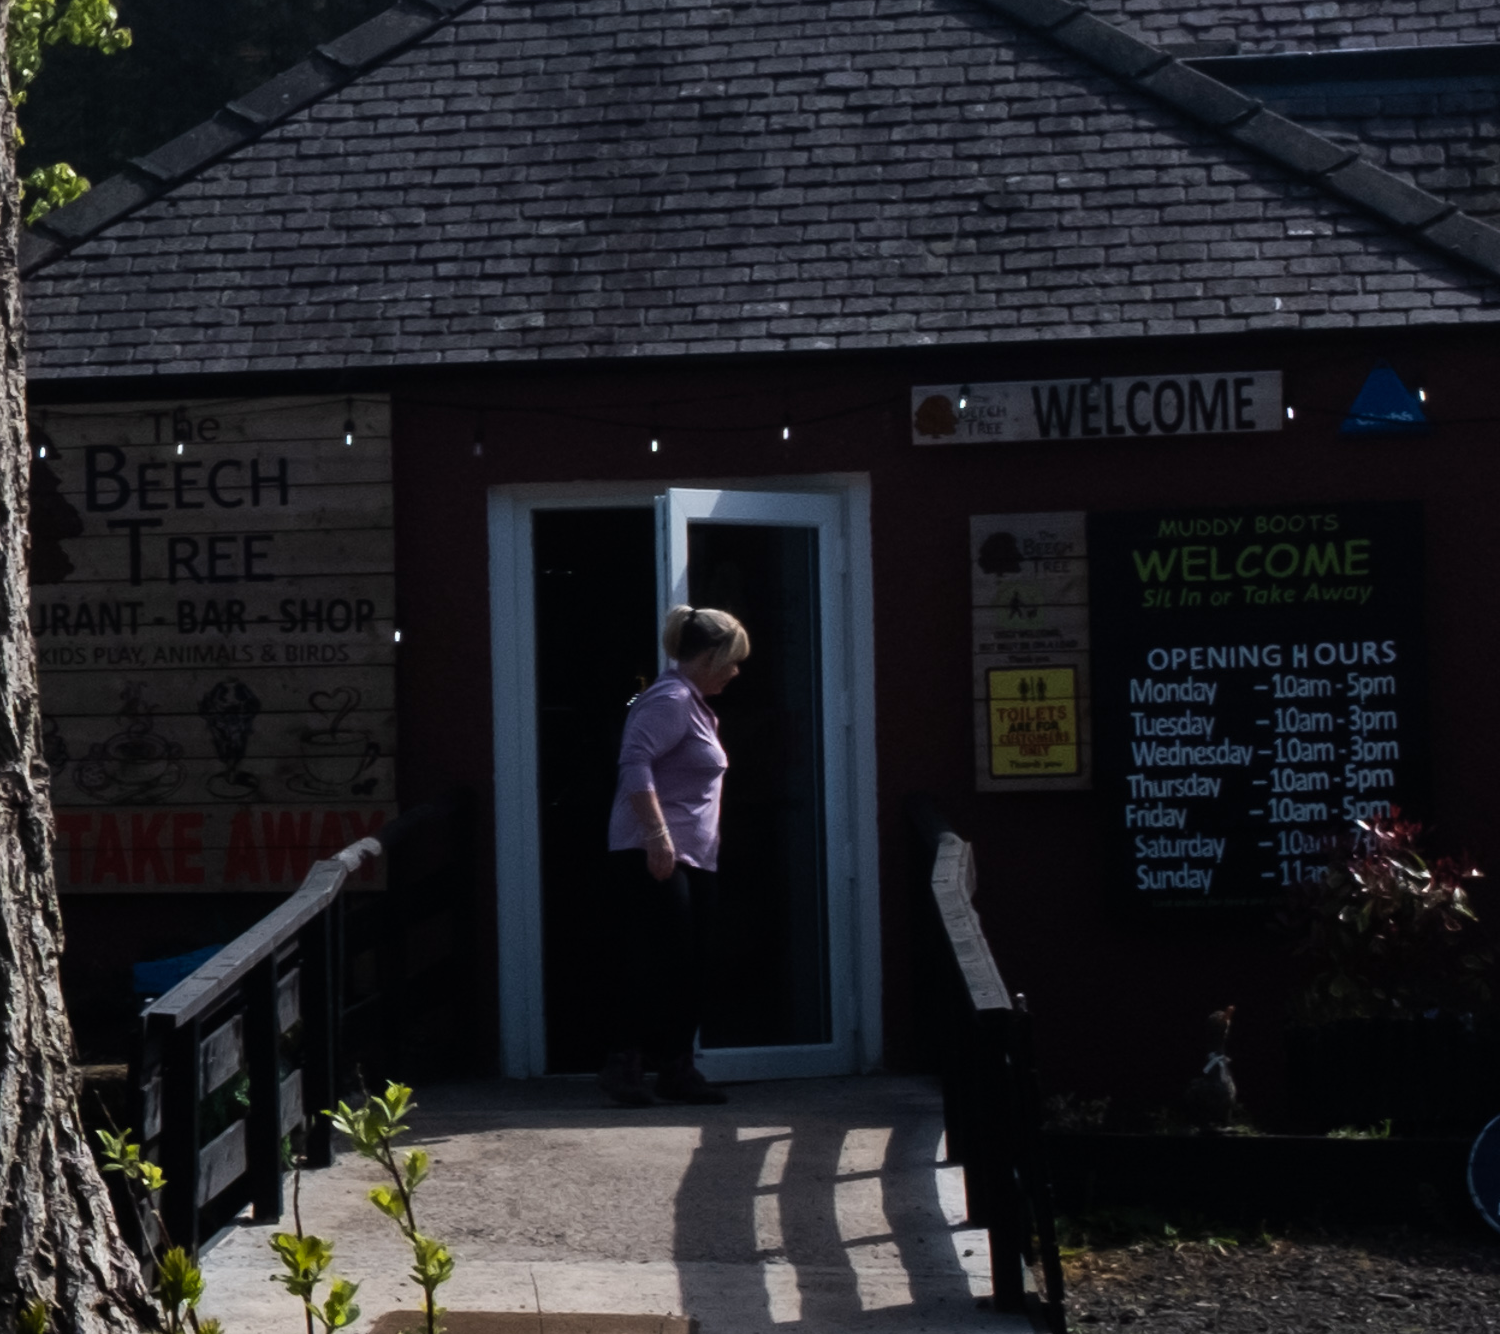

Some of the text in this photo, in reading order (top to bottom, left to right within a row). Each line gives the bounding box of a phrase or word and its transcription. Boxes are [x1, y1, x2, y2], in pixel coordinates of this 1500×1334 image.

[1032, 378, 1256, 437] WELCOME
[148, 407, 220, 443] The
[965, 418, 1003, 436] TREE
[85, 444, 288, 512] BEECH
[1156, 514, 1340, 538] MUDDY BOOTS
[107, 519, 275, 585] TREE
[1131, 538, 1372, 583] WELCOME
[1142, 581, 1374, 608] Sit In or Take Away
[177, 600, 246, 634] BAR
[279, 598, 374, 633] SHOP
[40, 643, 350, 668] KIDS PLAY, ANIMALS & BIRDS
[1147, 644, 1283, 671] OPENING
[1129, 676, 1217, 705] Monday
[997, 706, 1067, 722] TOILETS
[1009, 721, 1059, 733] ARE FOR
[1130, 709, 1215, 742] Tuesday
[1131, 737, 1253, 766] Wednesday
[1125, 772, 1222, 799] Thursday
[1125, 802, 1187, 830] Friday
[56, 810, 385, 885] TAKE AWAY
[1134, 832, 1227, 863] Saturday
[1136, 863, 1213, 894] Sunday
